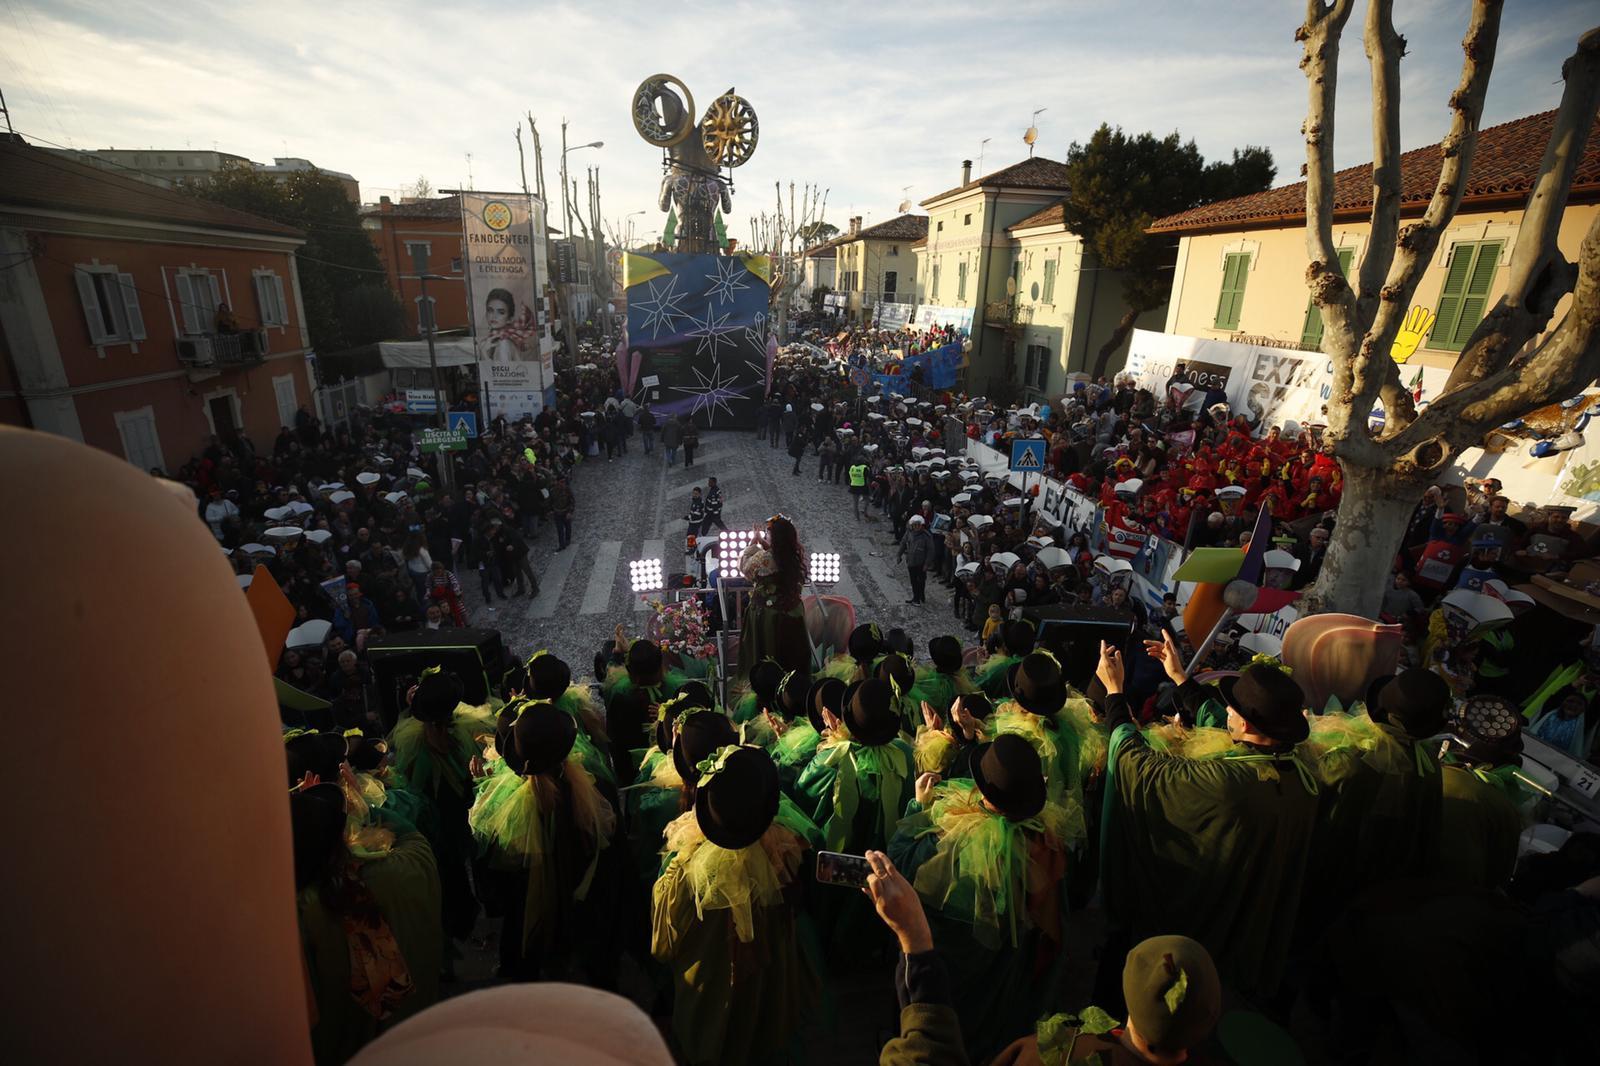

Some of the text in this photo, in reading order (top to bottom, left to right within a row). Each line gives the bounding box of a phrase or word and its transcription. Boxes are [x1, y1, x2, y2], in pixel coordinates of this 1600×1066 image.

[469, 233, 529, 245] FANOCENTER
[1252, 354, 1310, 387] EXT
[421, 436, 466, 444] EMERGENZA
[1577, 777, 1593, 791] 21
